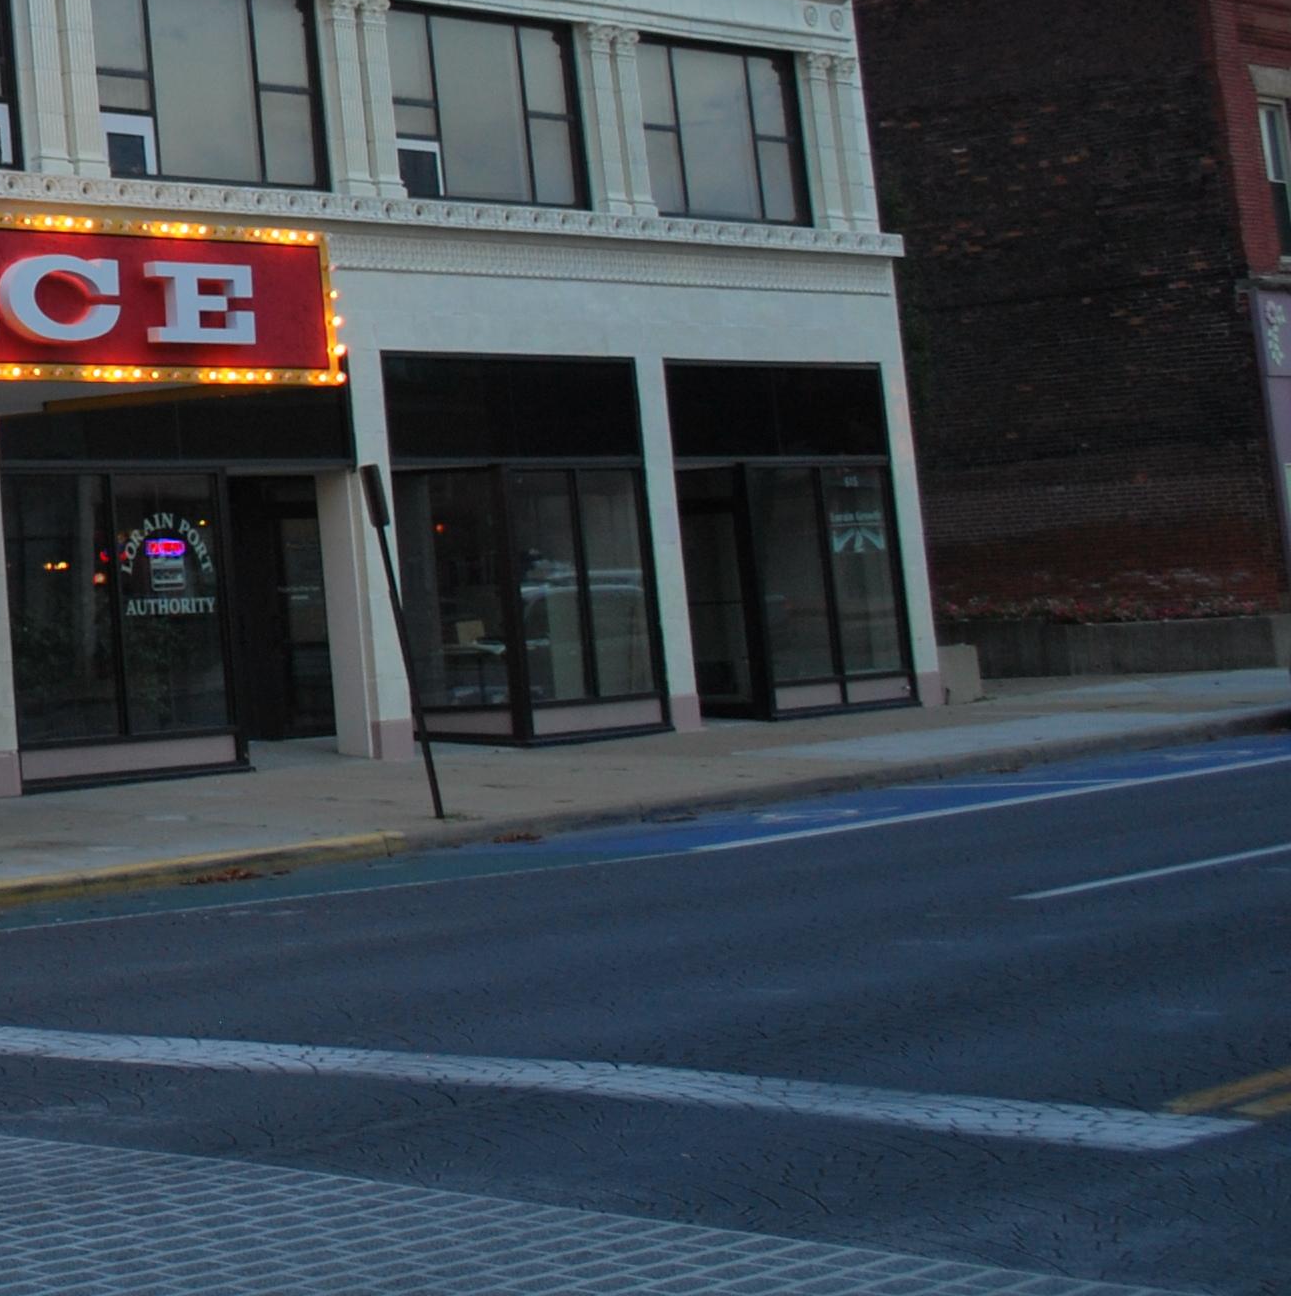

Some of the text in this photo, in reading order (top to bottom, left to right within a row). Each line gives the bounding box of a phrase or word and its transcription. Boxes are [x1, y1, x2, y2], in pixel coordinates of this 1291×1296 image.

[121, 512, 214, 576] LORAIN PORT
[125, 596, 216, 616] AUTHORITY
